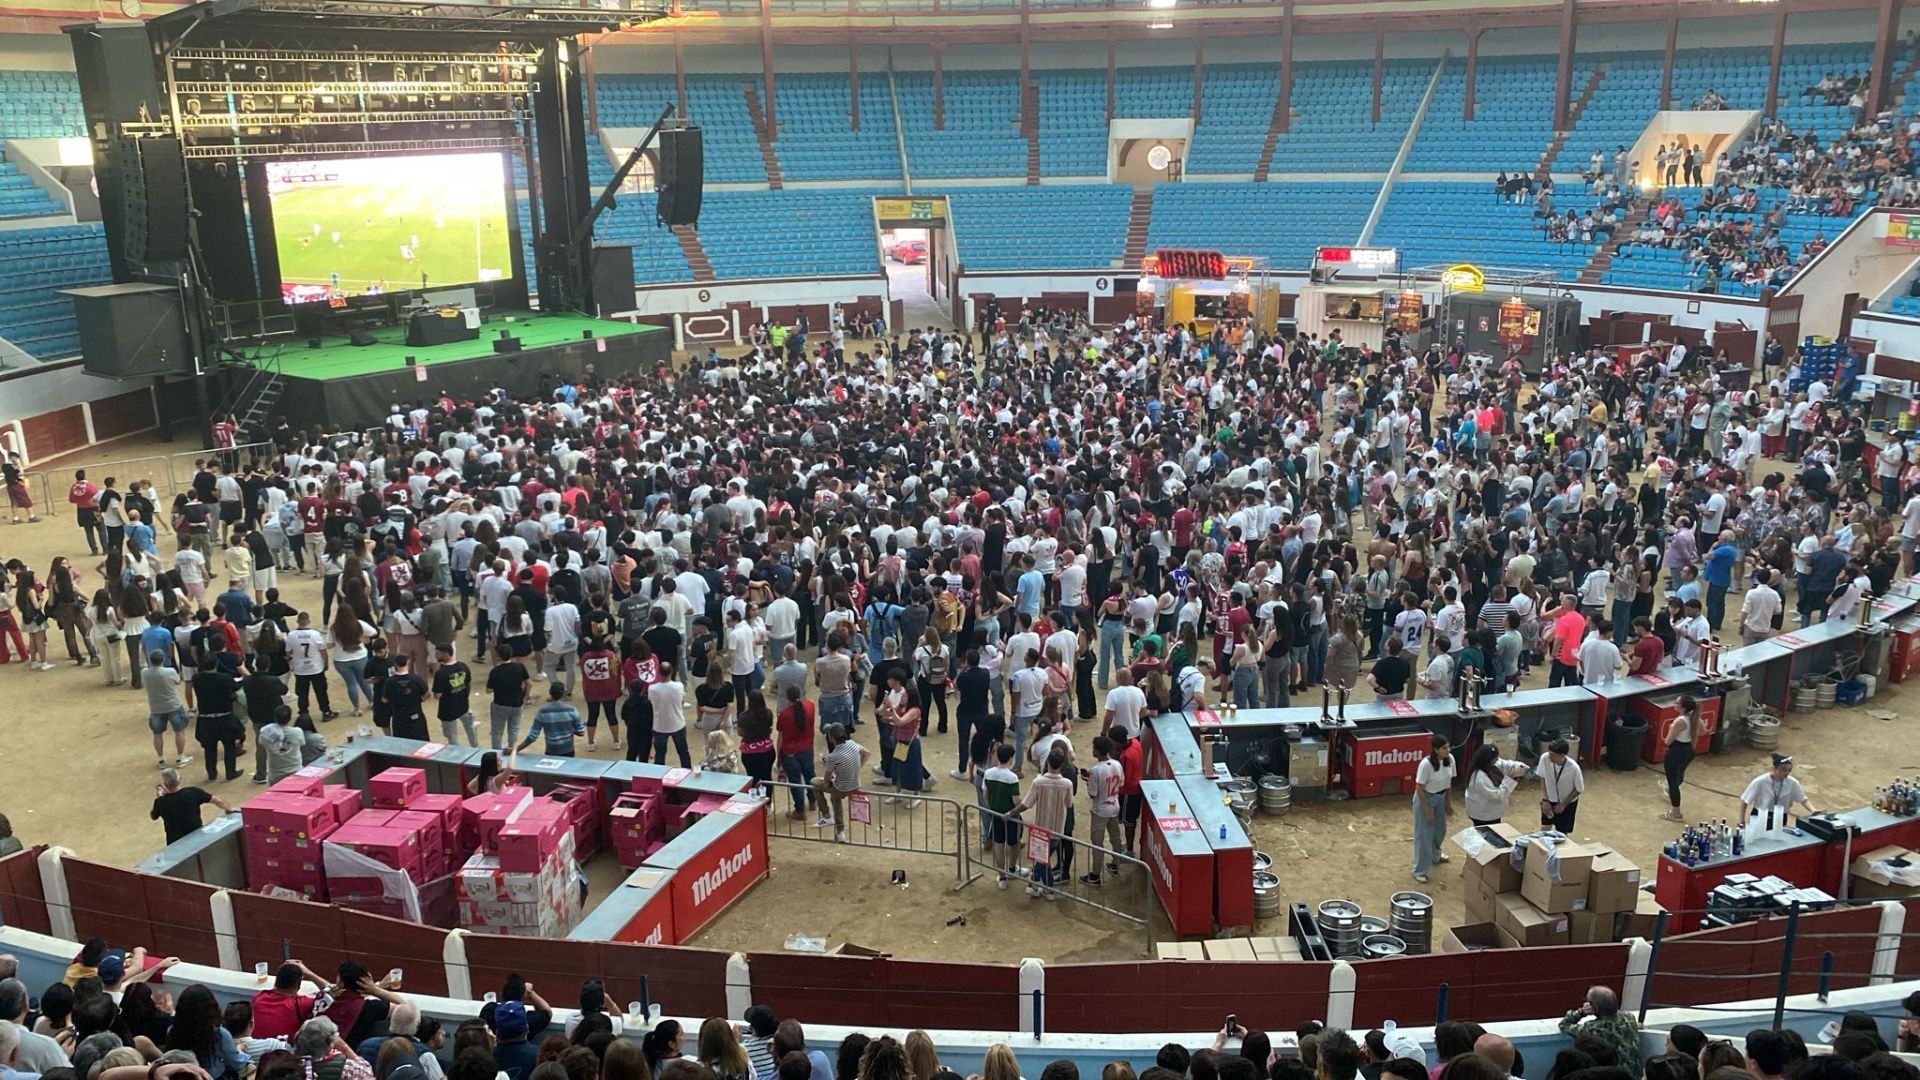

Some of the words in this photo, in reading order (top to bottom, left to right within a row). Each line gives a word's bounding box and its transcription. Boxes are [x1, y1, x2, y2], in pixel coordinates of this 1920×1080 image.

[1098, 279, 1105, 290] 4
[700, 291, 708, 300] 5
[307, 505, 316, 520] 4
[1407, 625, 1423, 642] 24
[300, 643, 310, 658] 7
[1364, 748, 1423, 766] Mahou
[1105, 774, 1121, 798] 12
[691, 843, 753, 907] Mahou
